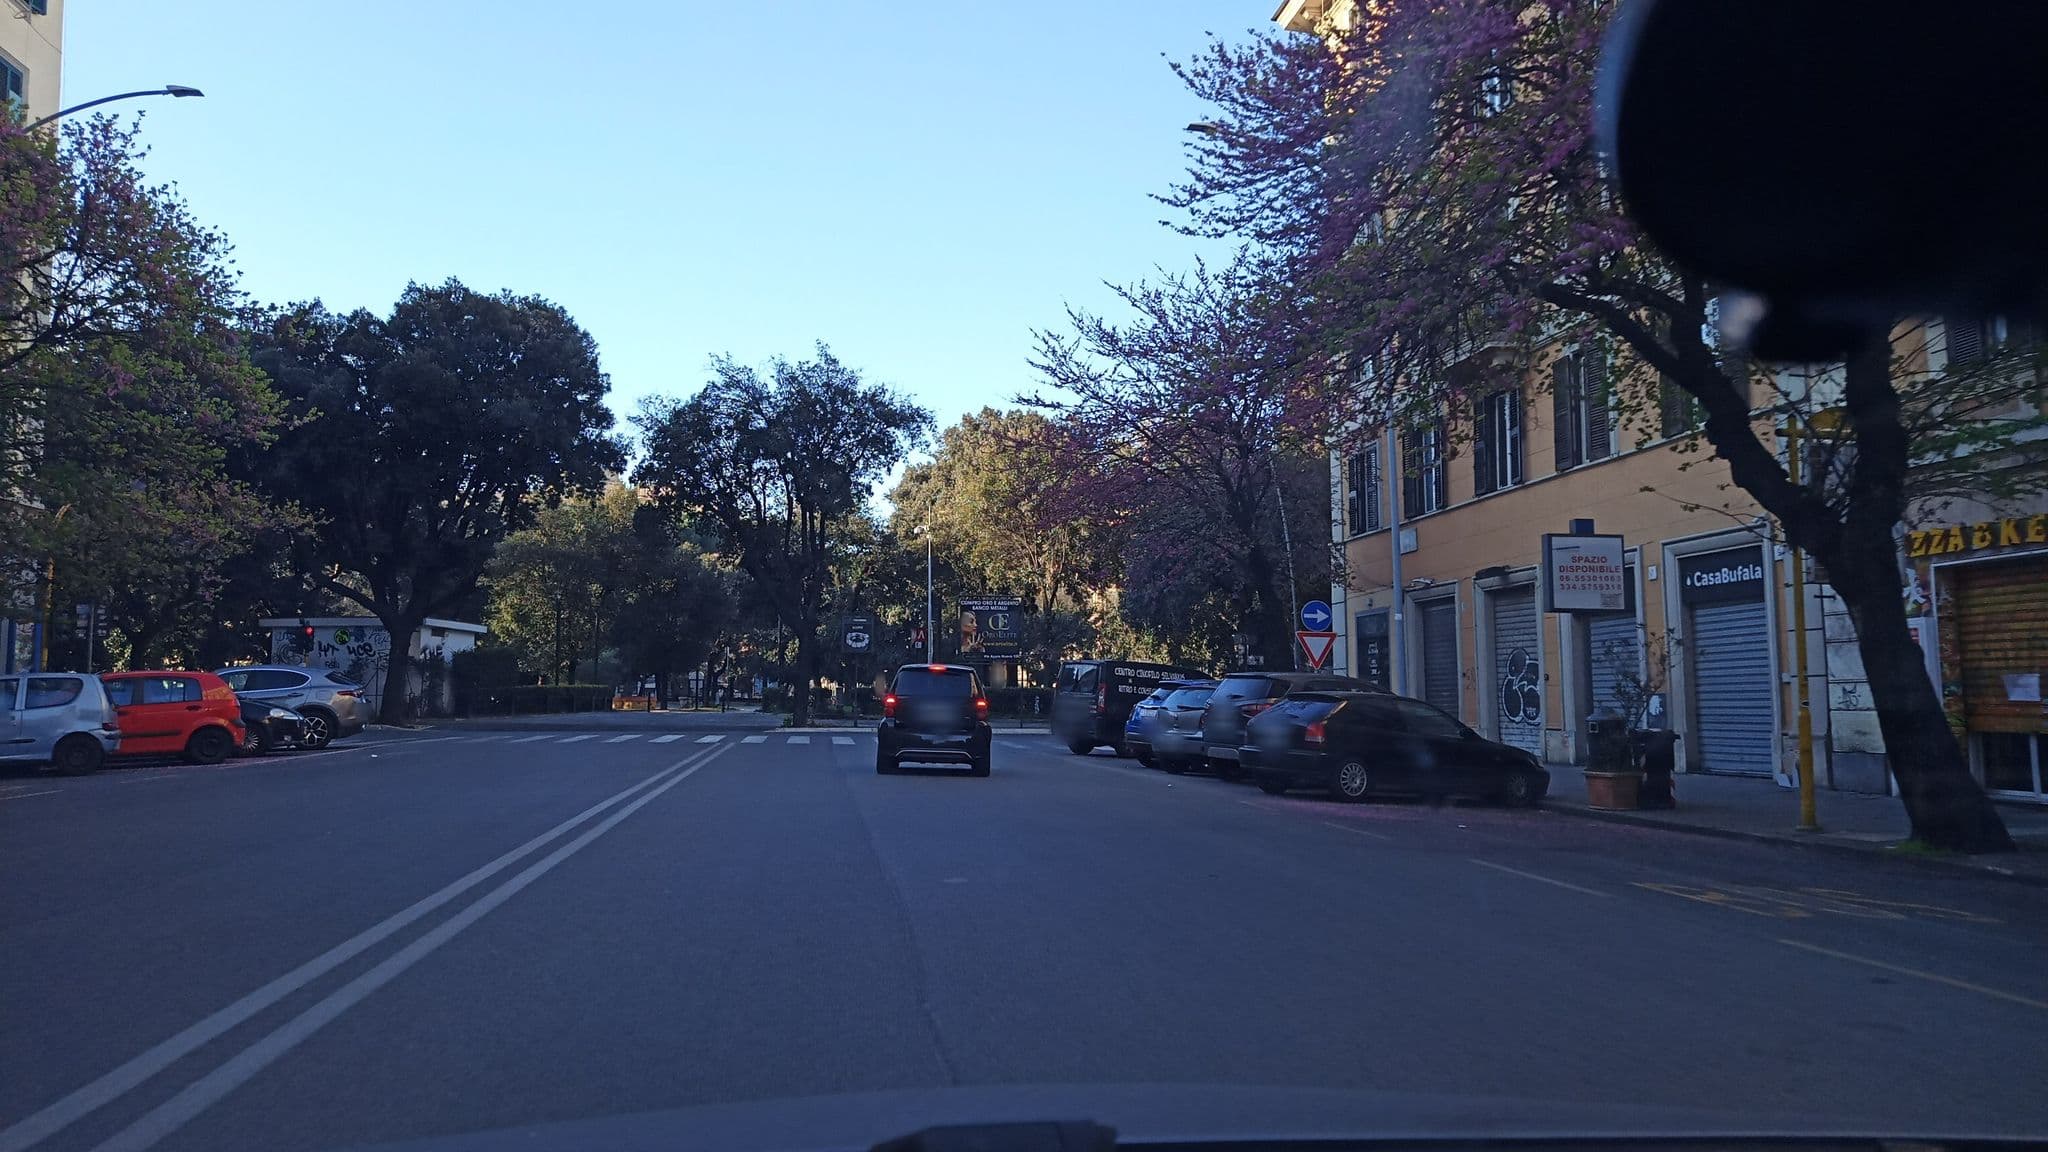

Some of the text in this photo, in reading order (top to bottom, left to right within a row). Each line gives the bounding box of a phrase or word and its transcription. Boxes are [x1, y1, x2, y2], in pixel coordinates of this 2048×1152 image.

[1571, 555, 1607, 563] SPAZIO
[1559, 565, 1621, 573] DISPONIBILE
[1694, 564, 1762, 587] CasaBufala
[1114, 667, 1136, 677] CENTRO
[1136, 669, 1160, 679] CINOFILO
